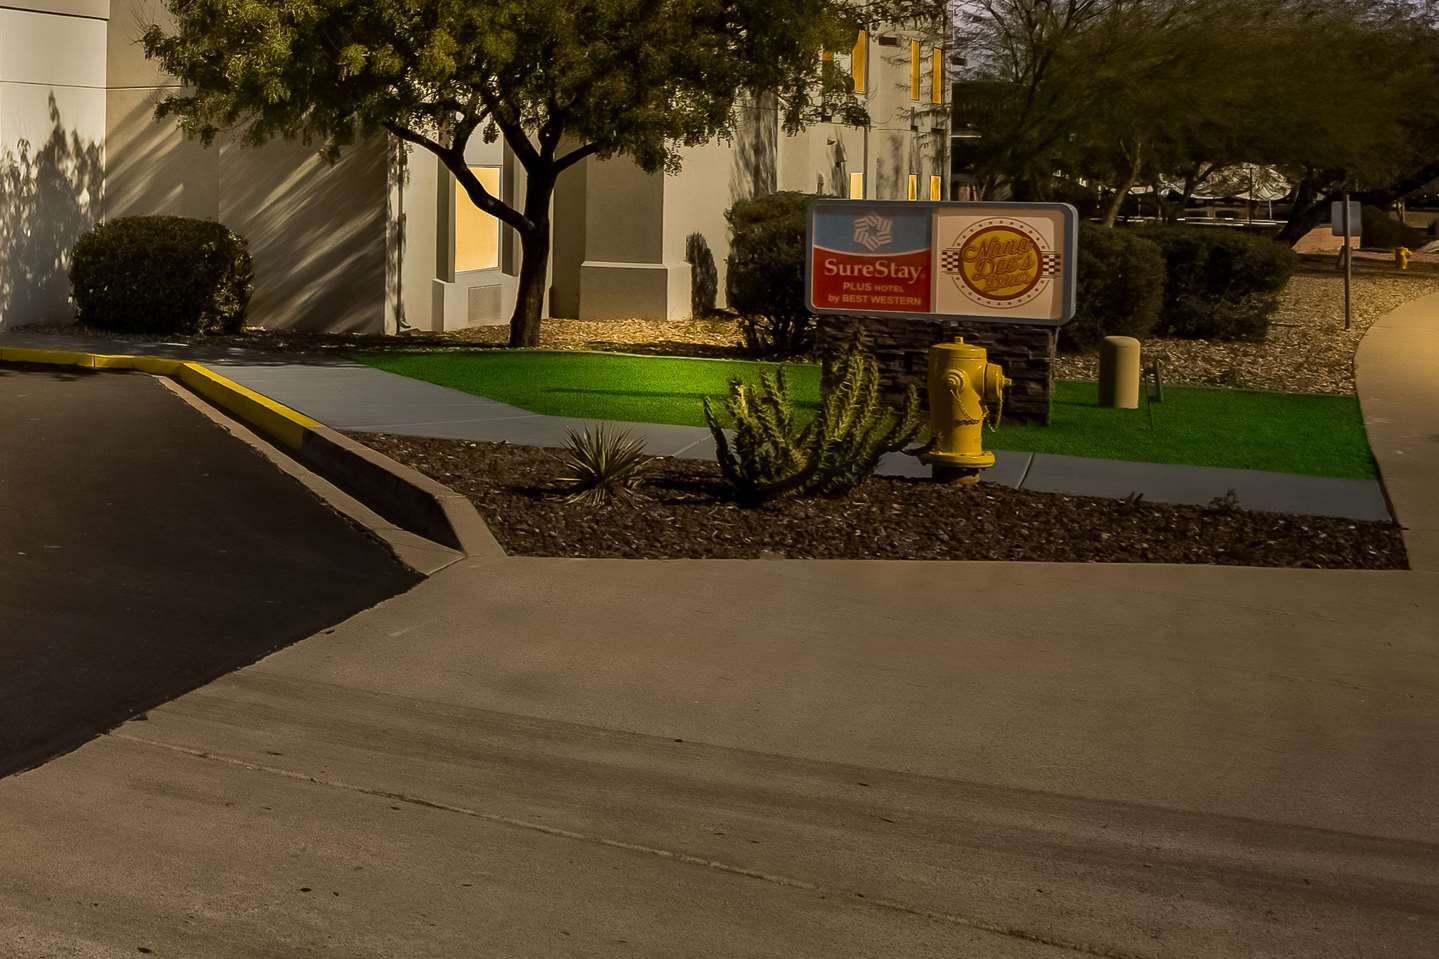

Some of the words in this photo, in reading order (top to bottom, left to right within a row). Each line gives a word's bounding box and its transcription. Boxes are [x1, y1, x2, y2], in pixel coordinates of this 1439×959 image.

[824, 258, 921, 284] SureStay
[843, 281, 872, 292] PLUS
[874, 284, 905, 293] HOTEL
[828, 293, 840, 304] by
[842, 294, 868, 303] BEST
[871, 295, 922, 305] WESTERN
